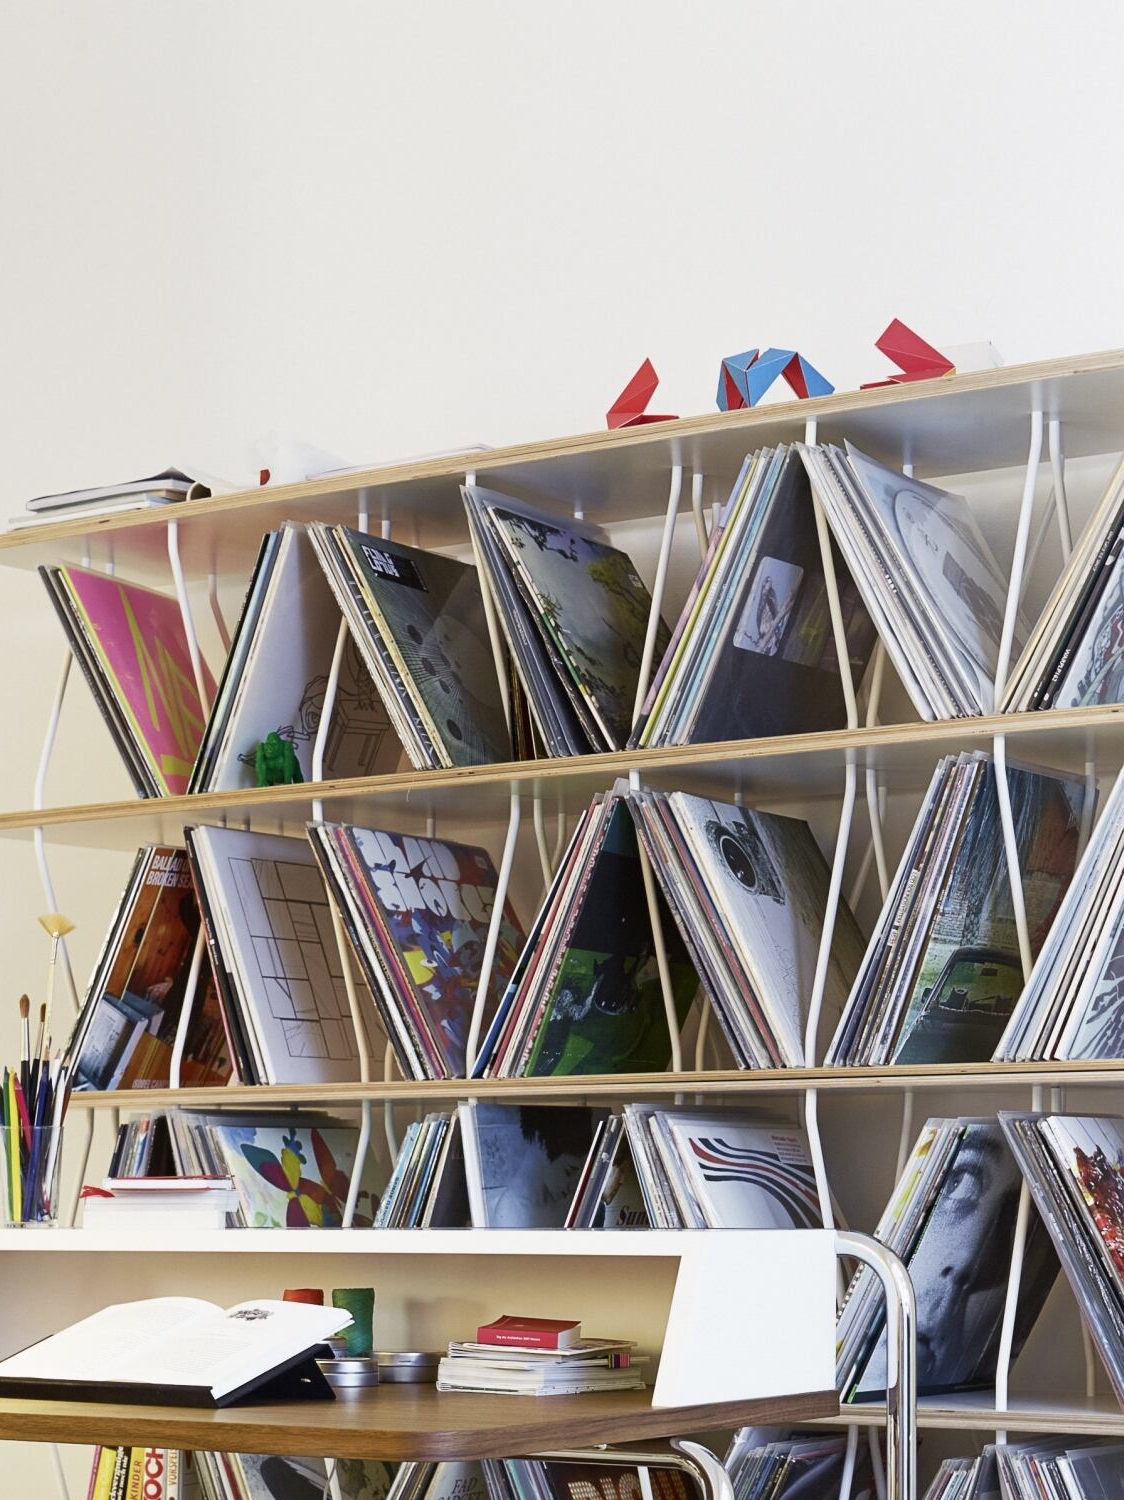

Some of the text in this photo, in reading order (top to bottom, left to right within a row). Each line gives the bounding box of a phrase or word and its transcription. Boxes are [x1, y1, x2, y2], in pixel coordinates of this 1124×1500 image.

[146, 871, 179, 887] BROKEN
[130, 1460, 142, 1500] KINDER
[451, 1478, 478, 1495] FAD
